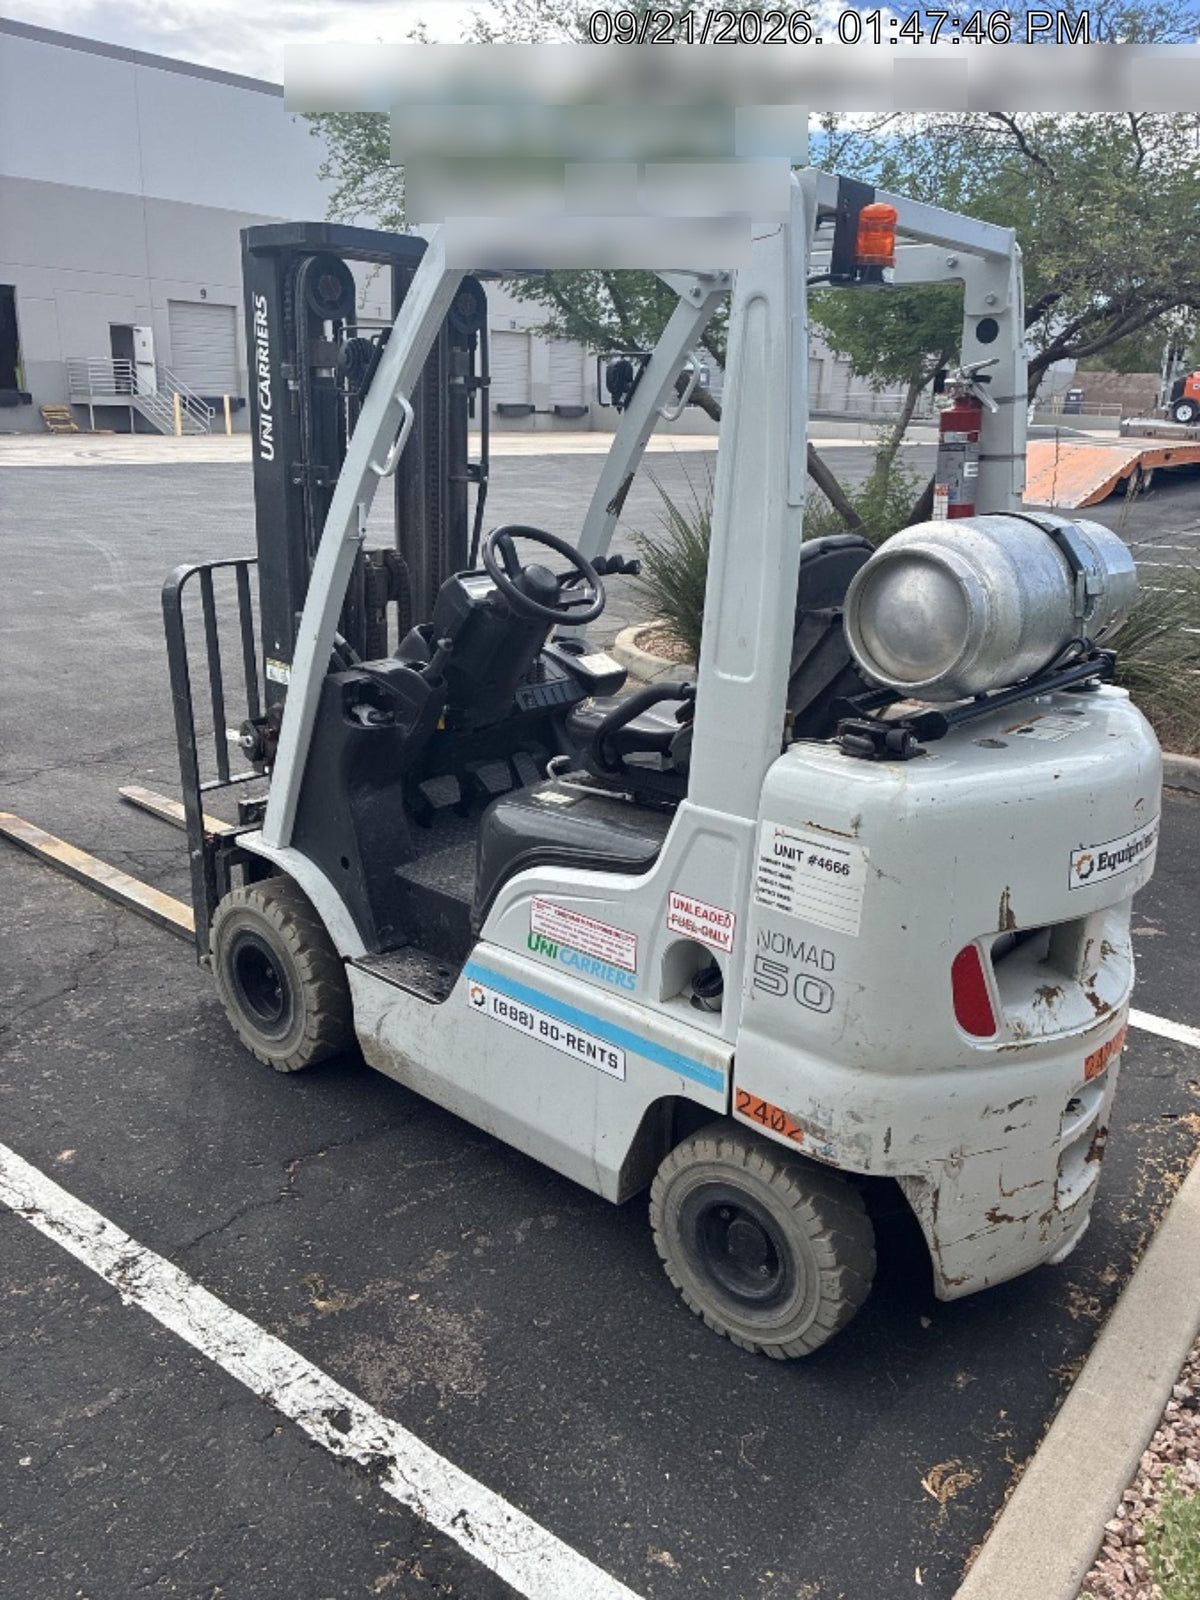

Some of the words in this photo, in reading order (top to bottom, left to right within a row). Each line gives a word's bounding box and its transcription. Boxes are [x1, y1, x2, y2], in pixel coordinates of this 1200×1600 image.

[774, 843, 805, 863] UNIT
[807, 854, 851, 877] #4666
[672, 897, 733, 929] UNLEADED
[699, 926, 731, 944] ONLY
[757, 928, 835, 972] NOMAD
[753, 955, 835, 1014] 50
[493, 997, 534, 1030] (888)
[540, 1020, 619, 1070] 80-RENTS
